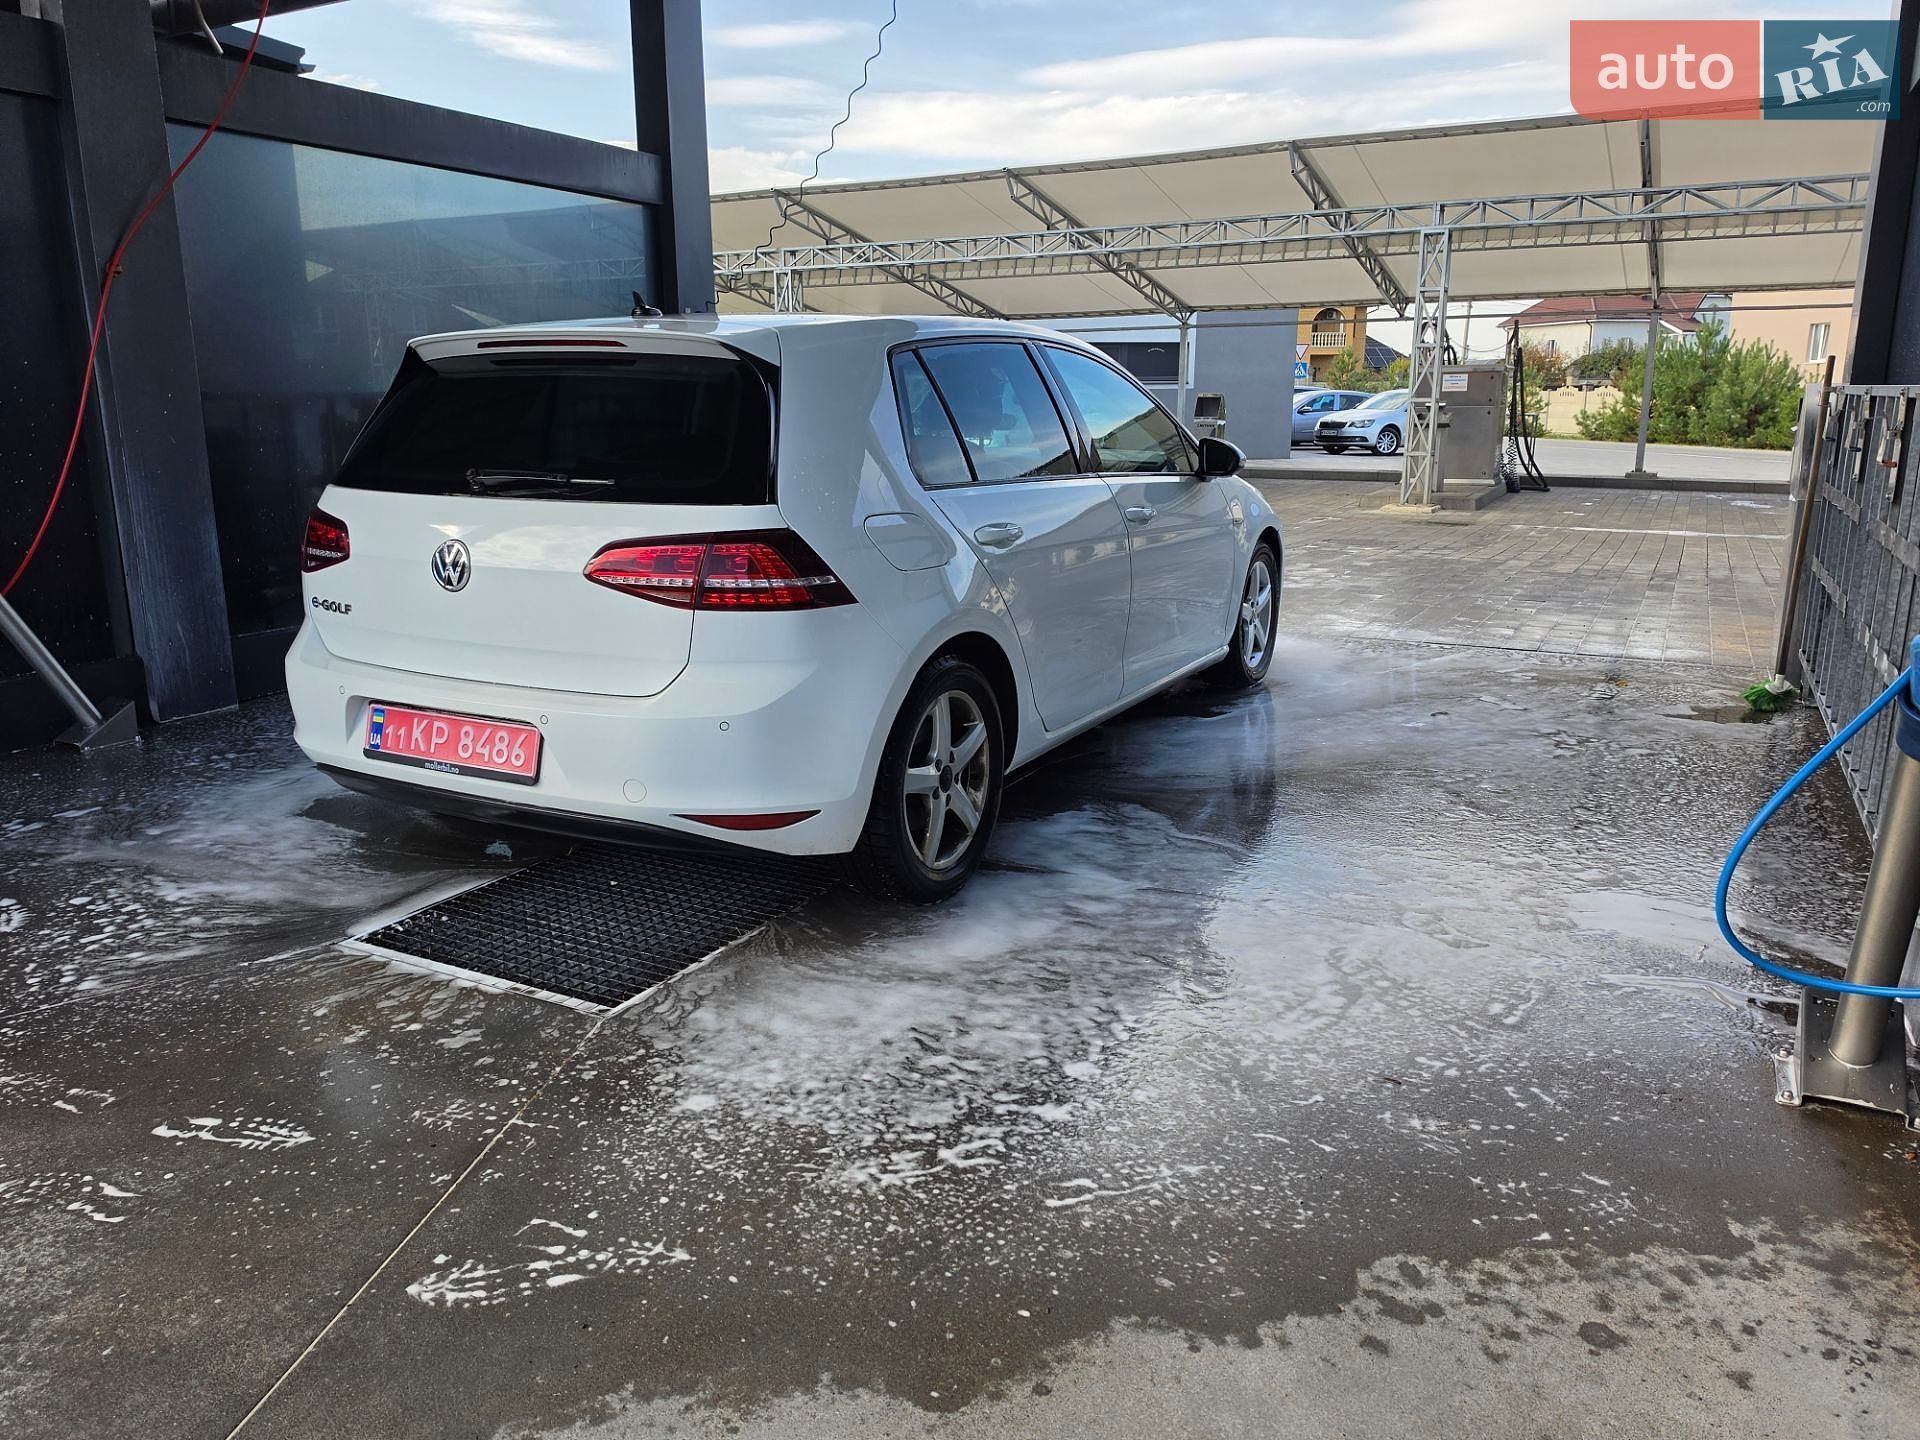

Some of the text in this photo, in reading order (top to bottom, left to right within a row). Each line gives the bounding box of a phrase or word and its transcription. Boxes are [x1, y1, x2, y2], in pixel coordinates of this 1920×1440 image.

[311, 596, 352, 615] e-GOLF
[370, 732, 381, 746] UA
[457, 725, 529, 767] 8486
